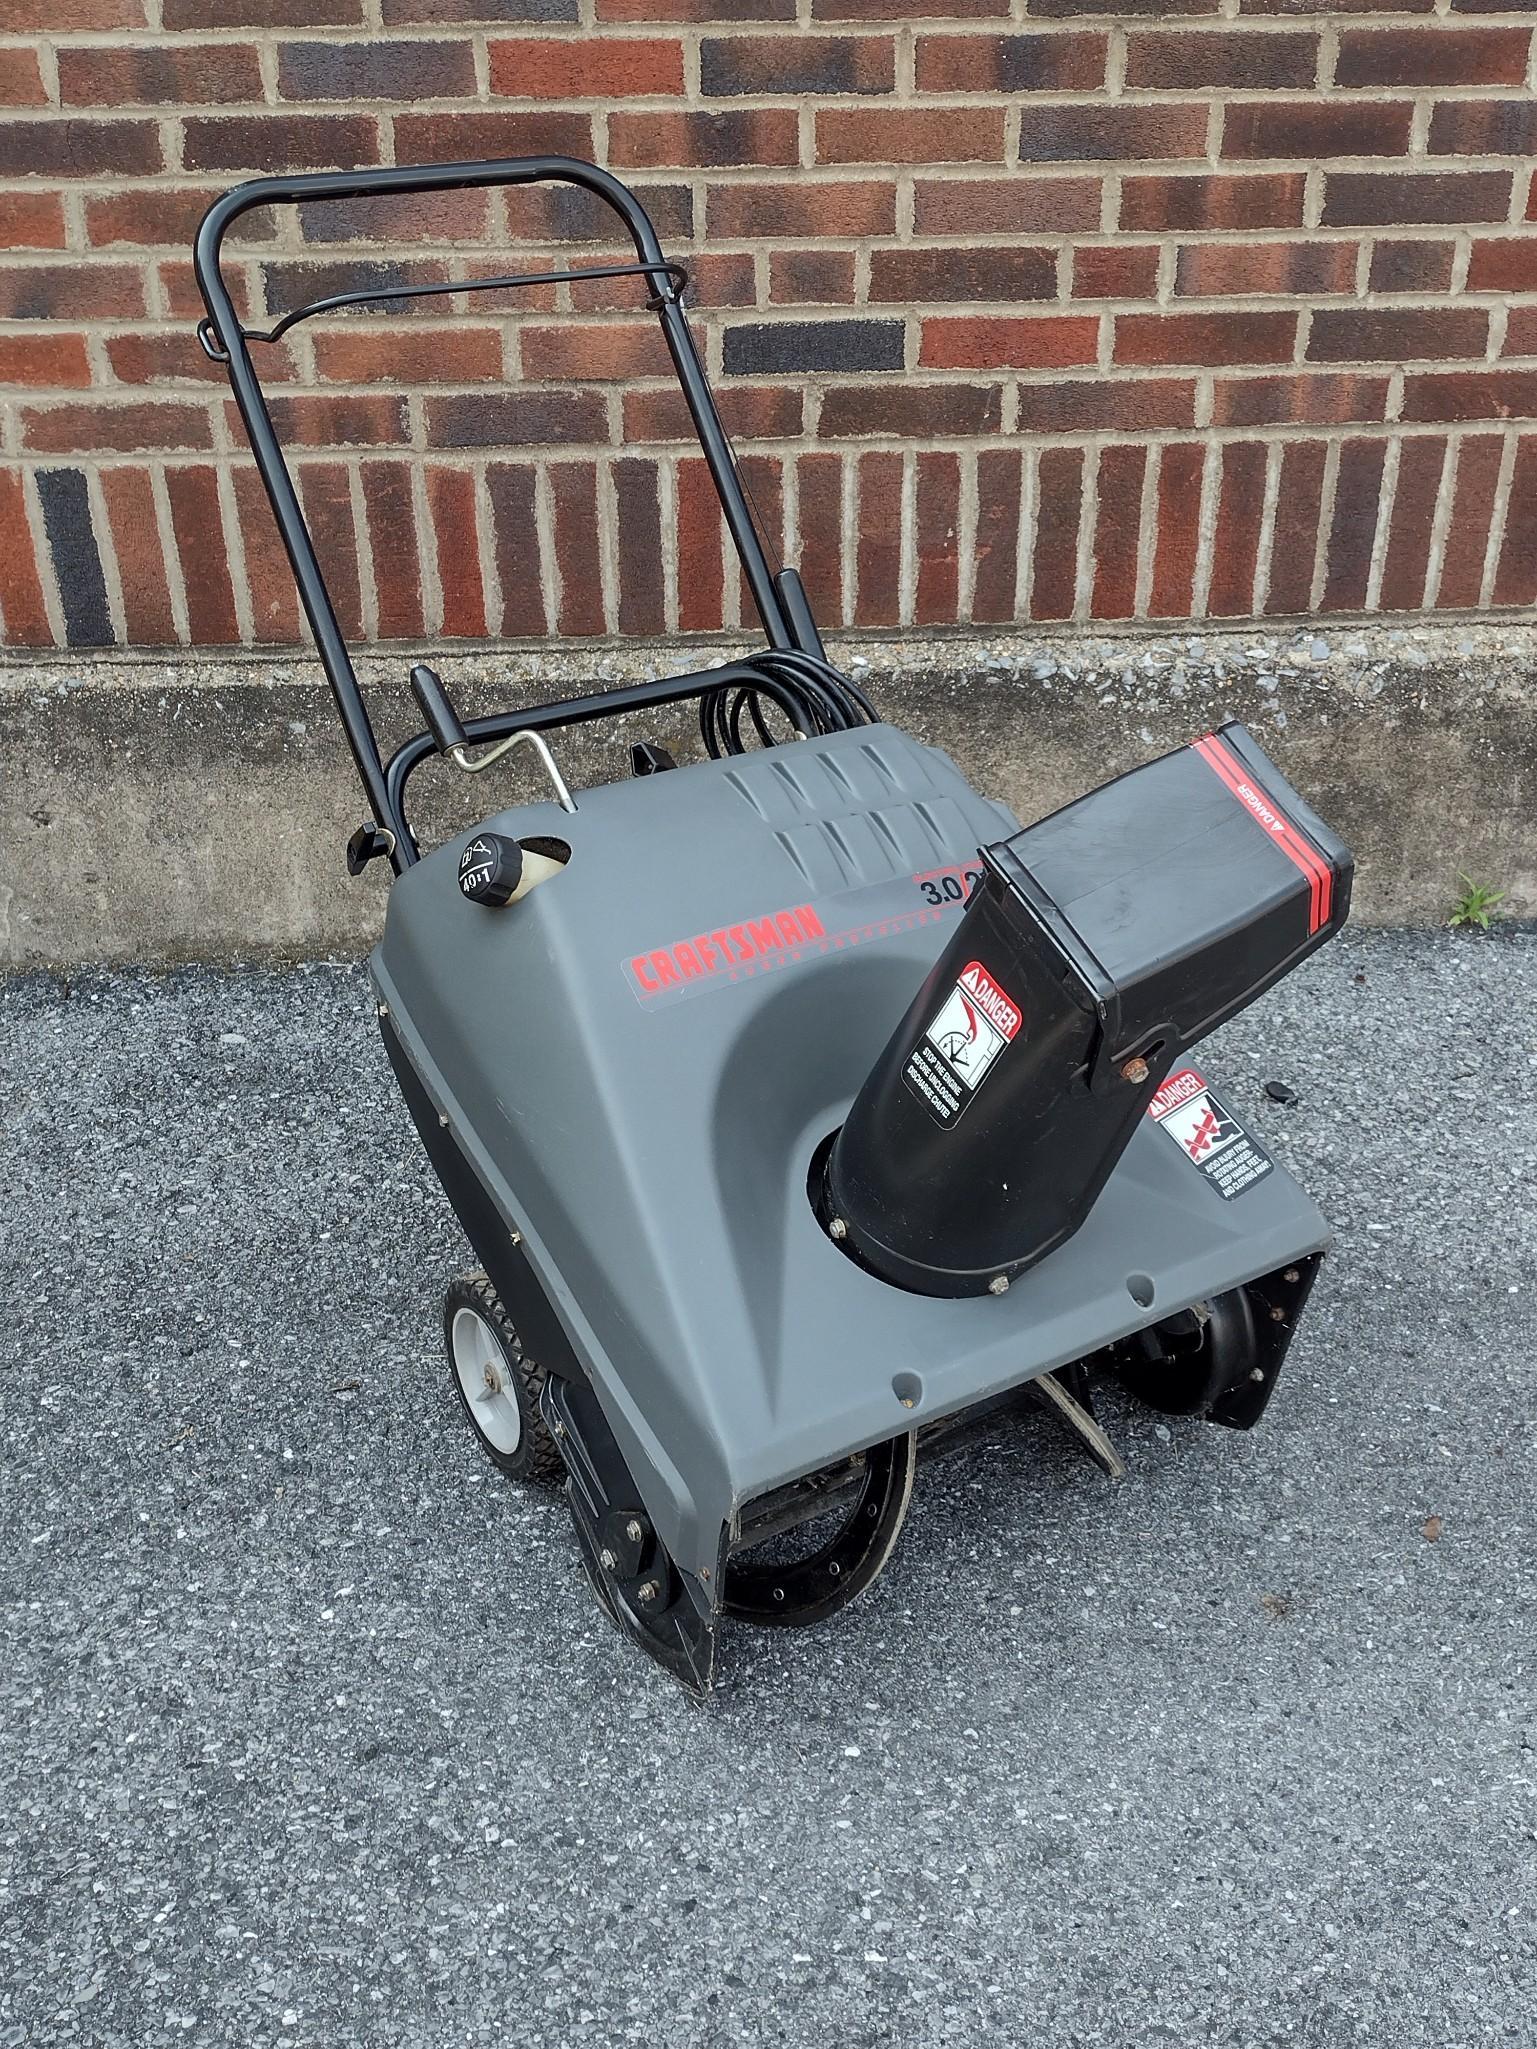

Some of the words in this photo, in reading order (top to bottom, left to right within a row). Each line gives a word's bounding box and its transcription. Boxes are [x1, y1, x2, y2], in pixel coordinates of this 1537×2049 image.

[1237, 783, 1276, 825] DANGER
[463, 868, 491, 892] 40:1
[631, 904, 826, 991] CRAFTSMAN
[974, 978, 1018, 1034] DANGER
[911, 1051, 932, 1077] BEFORE
[927, 1072, 960, 1112] UNCLOGGING
[922, 1046, 938, 1063] STOP
[934, 1060, 947, 1076] THE
[942, 1072, 963, 1097] ENGINE
[906, 1064, 935, 1099] DISCHARGE
[930, 1094, 951, 1119] CHUTE!
[1160, 1073, 1202, 1110] DANGER
[1212, 1159, 1237, 1180] ROTATING
[1217, 1148, 1237, 1164] INJURY
[1233, 1139, 1250, 1154] FROM
[1218, 1174, 1233, 1188] KEEP
[1222, 1185, 1235, 1198] AND
[1232, 1169, 1258, 1191] CLOTHING
